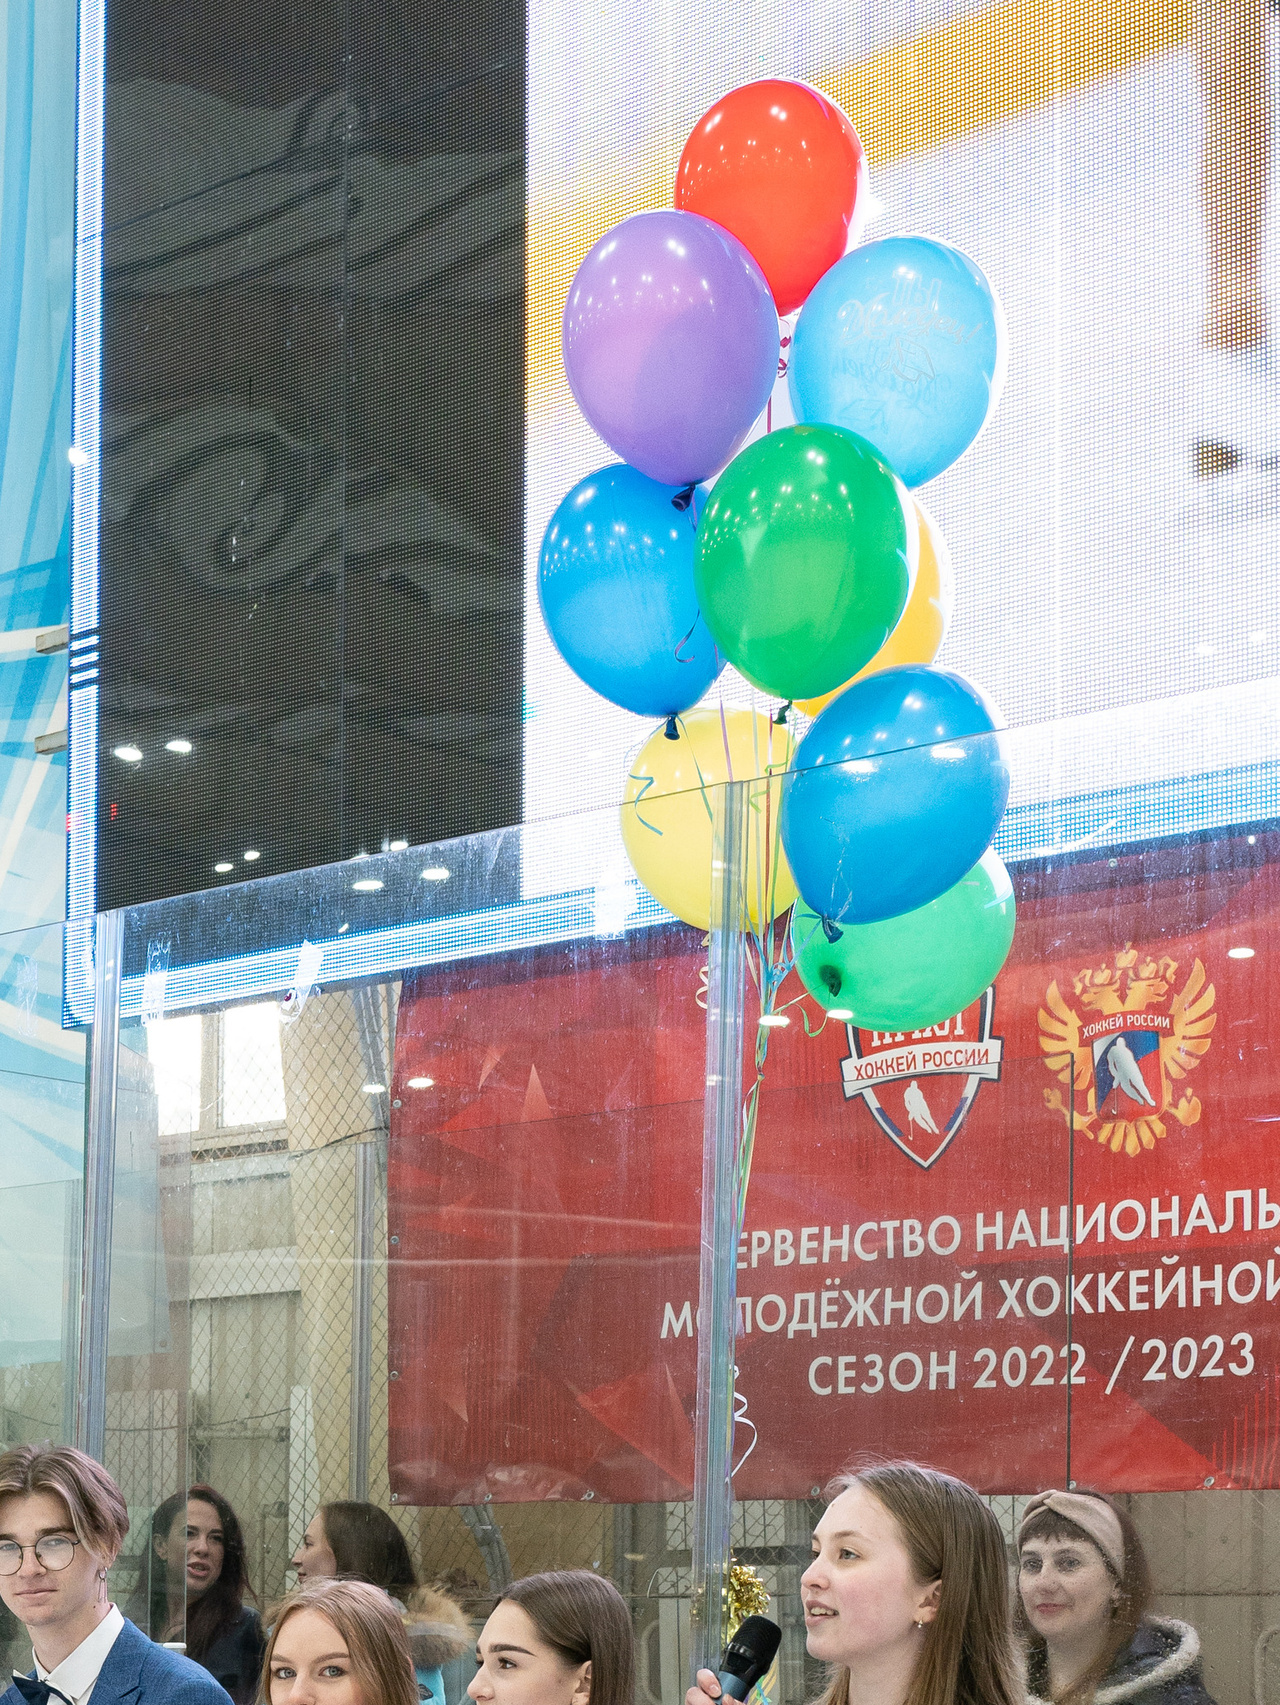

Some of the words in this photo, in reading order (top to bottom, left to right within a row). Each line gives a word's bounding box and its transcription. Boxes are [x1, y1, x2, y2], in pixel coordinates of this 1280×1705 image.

[1082, 1014, 1124, 1039] ХОККЕЙ
[1126, 1014, 1170, 1030] РОССИИ
[853, 1050, 918, 1081] ХОККЕЙ
[922, 1048, 990, 1070] РОССИИ
[735, 1214, 962, 1270] ЕРВЕНСТВО
[660, 1270, 983, 1339] МЛОДЁЖНОЙ
[808, 1351, 957, 1395] СЕЗОН
[973, 1343, 1086, 1389] 2022
